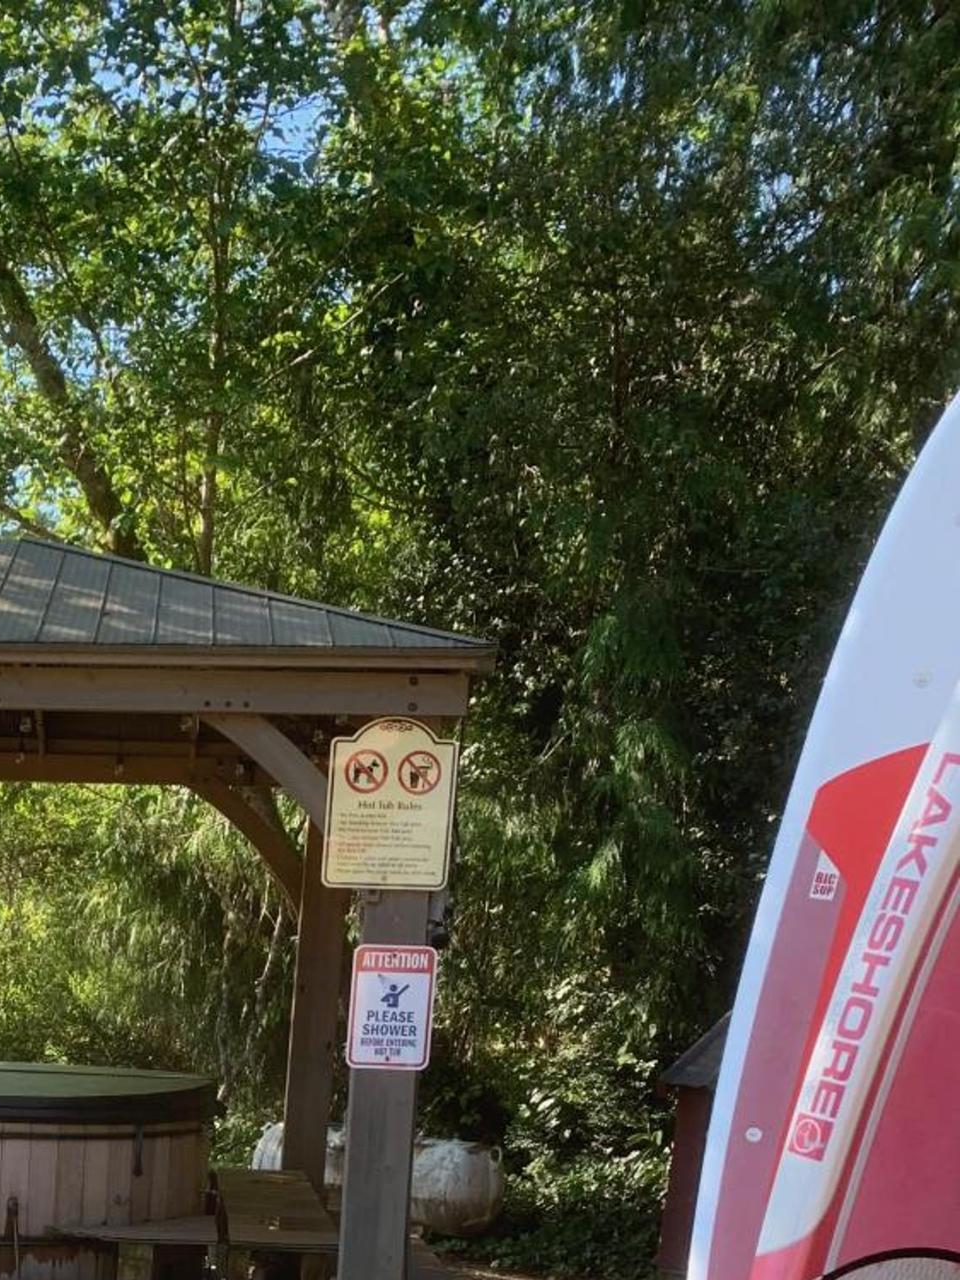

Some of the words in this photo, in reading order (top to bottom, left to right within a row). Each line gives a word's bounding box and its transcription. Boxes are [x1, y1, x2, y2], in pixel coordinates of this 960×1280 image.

[815, 871, 837, 885] BIC
[812, 883, 835, 897] SUP
[810, 752, 960, 1120] LAKESHORE
[362, 952, 428, 969] ATTENTION
[366, 1010, 415, 1023] PLEASE
[362, 1024, 417, 1036] SHOWER
